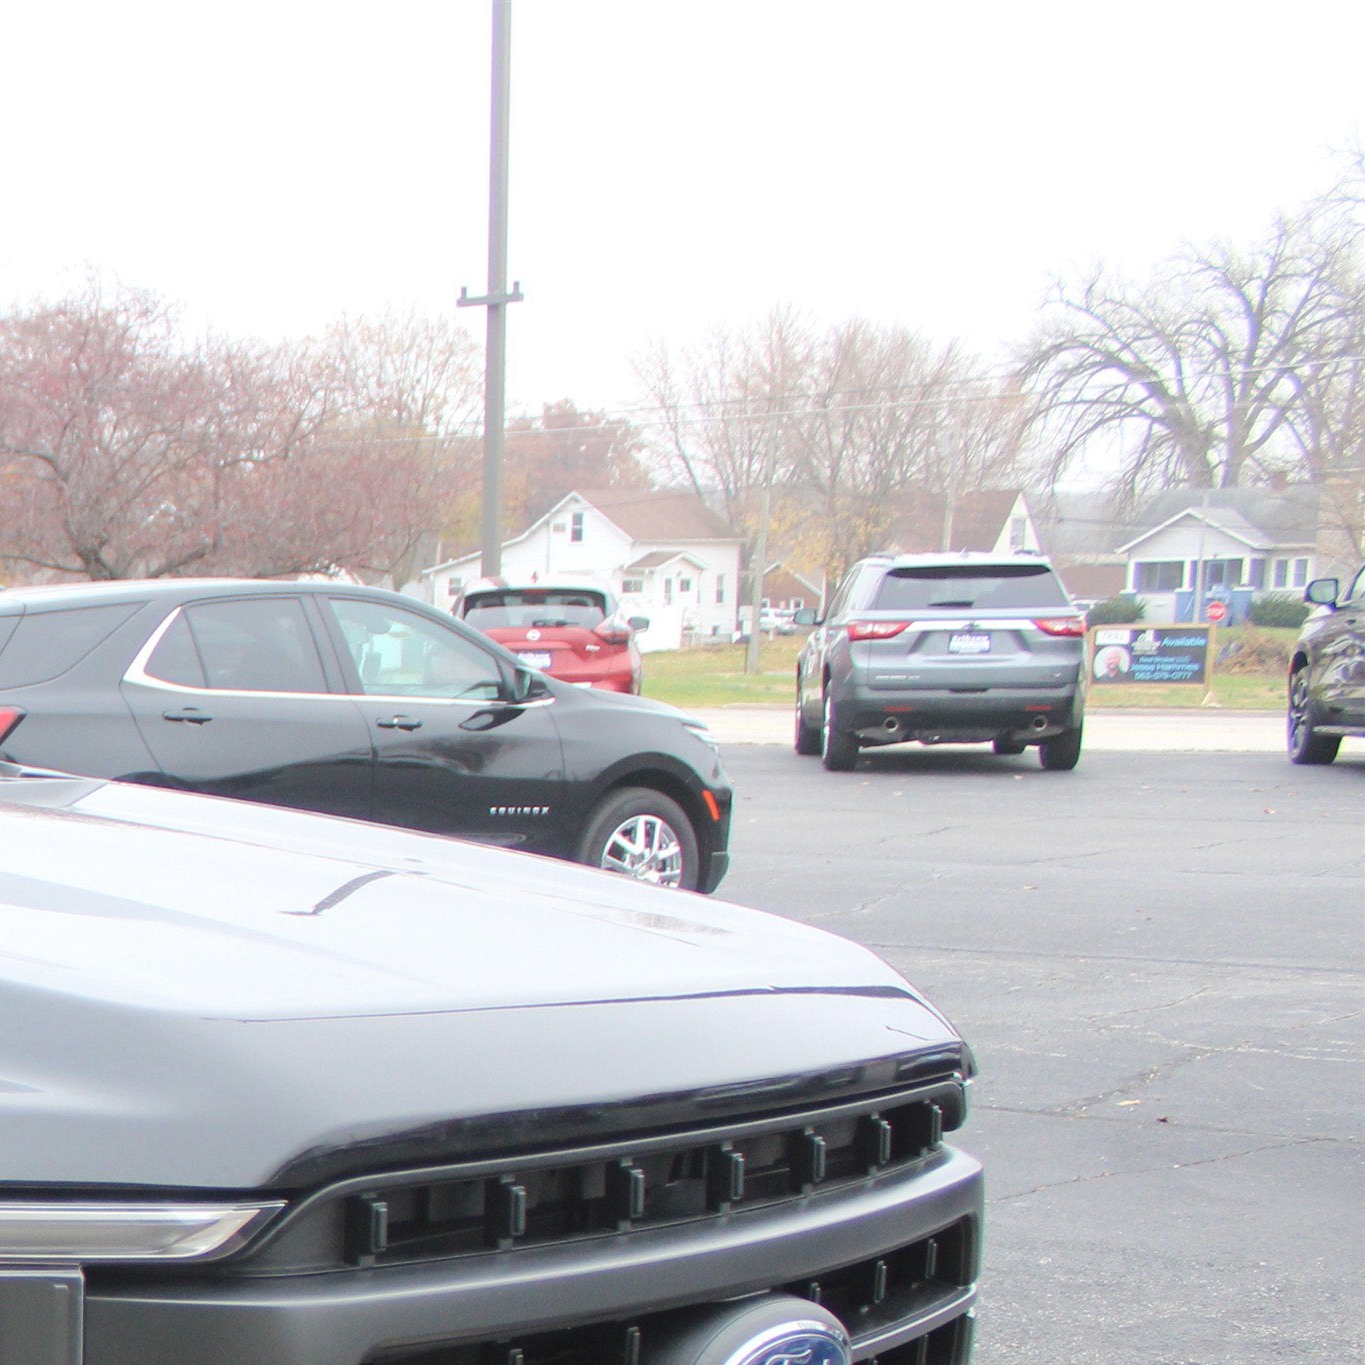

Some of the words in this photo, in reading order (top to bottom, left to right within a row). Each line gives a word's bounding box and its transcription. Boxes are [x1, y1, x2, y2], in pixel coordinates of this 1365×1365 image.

[1207, 607, 1225, 617] STOP
[1161, 636, 1206, 648] Available
[489, 806, 550, 815] EQUINOX
